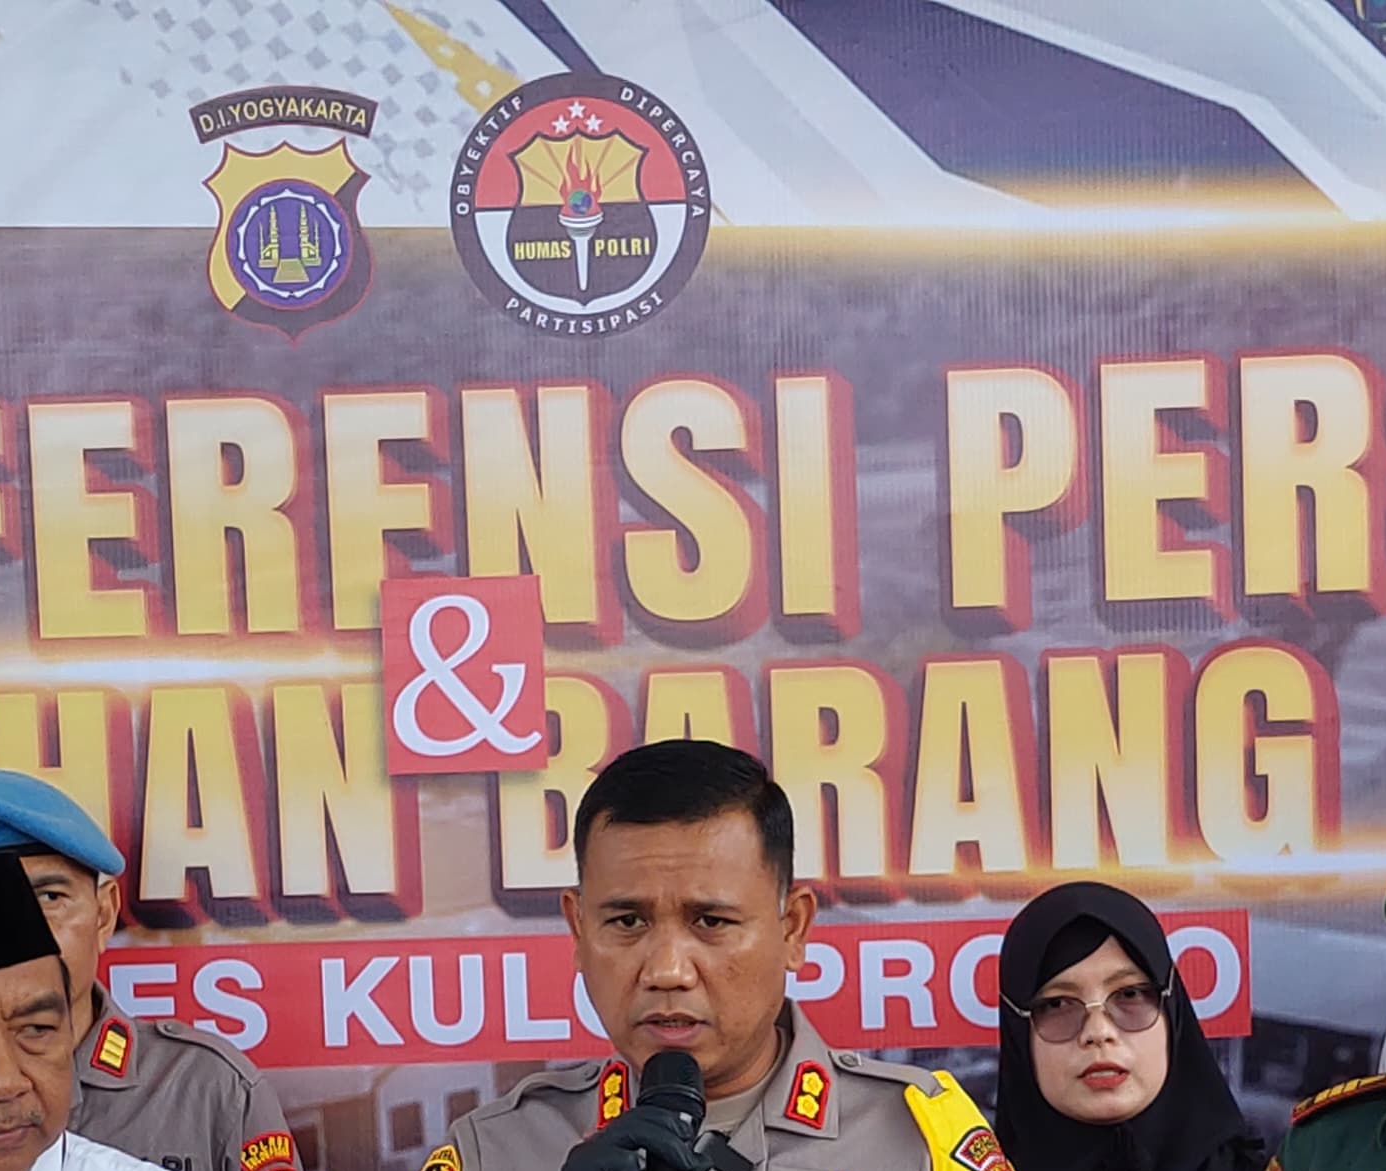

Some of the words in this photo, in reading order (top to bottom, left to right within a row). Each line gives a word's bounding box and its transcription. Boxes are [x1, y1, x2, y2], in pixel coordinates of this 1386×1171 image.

[456, 94, 524, 216] OBYEKTIF
[618, 86, 706, 219] DIPERCAYA
[514, 239, 571, 260] HUMAS
[594, 237, 651, 258] POLRI
[506, 293, 663, 334] PARTISIPASI
[391, 593, 543, 758] &
